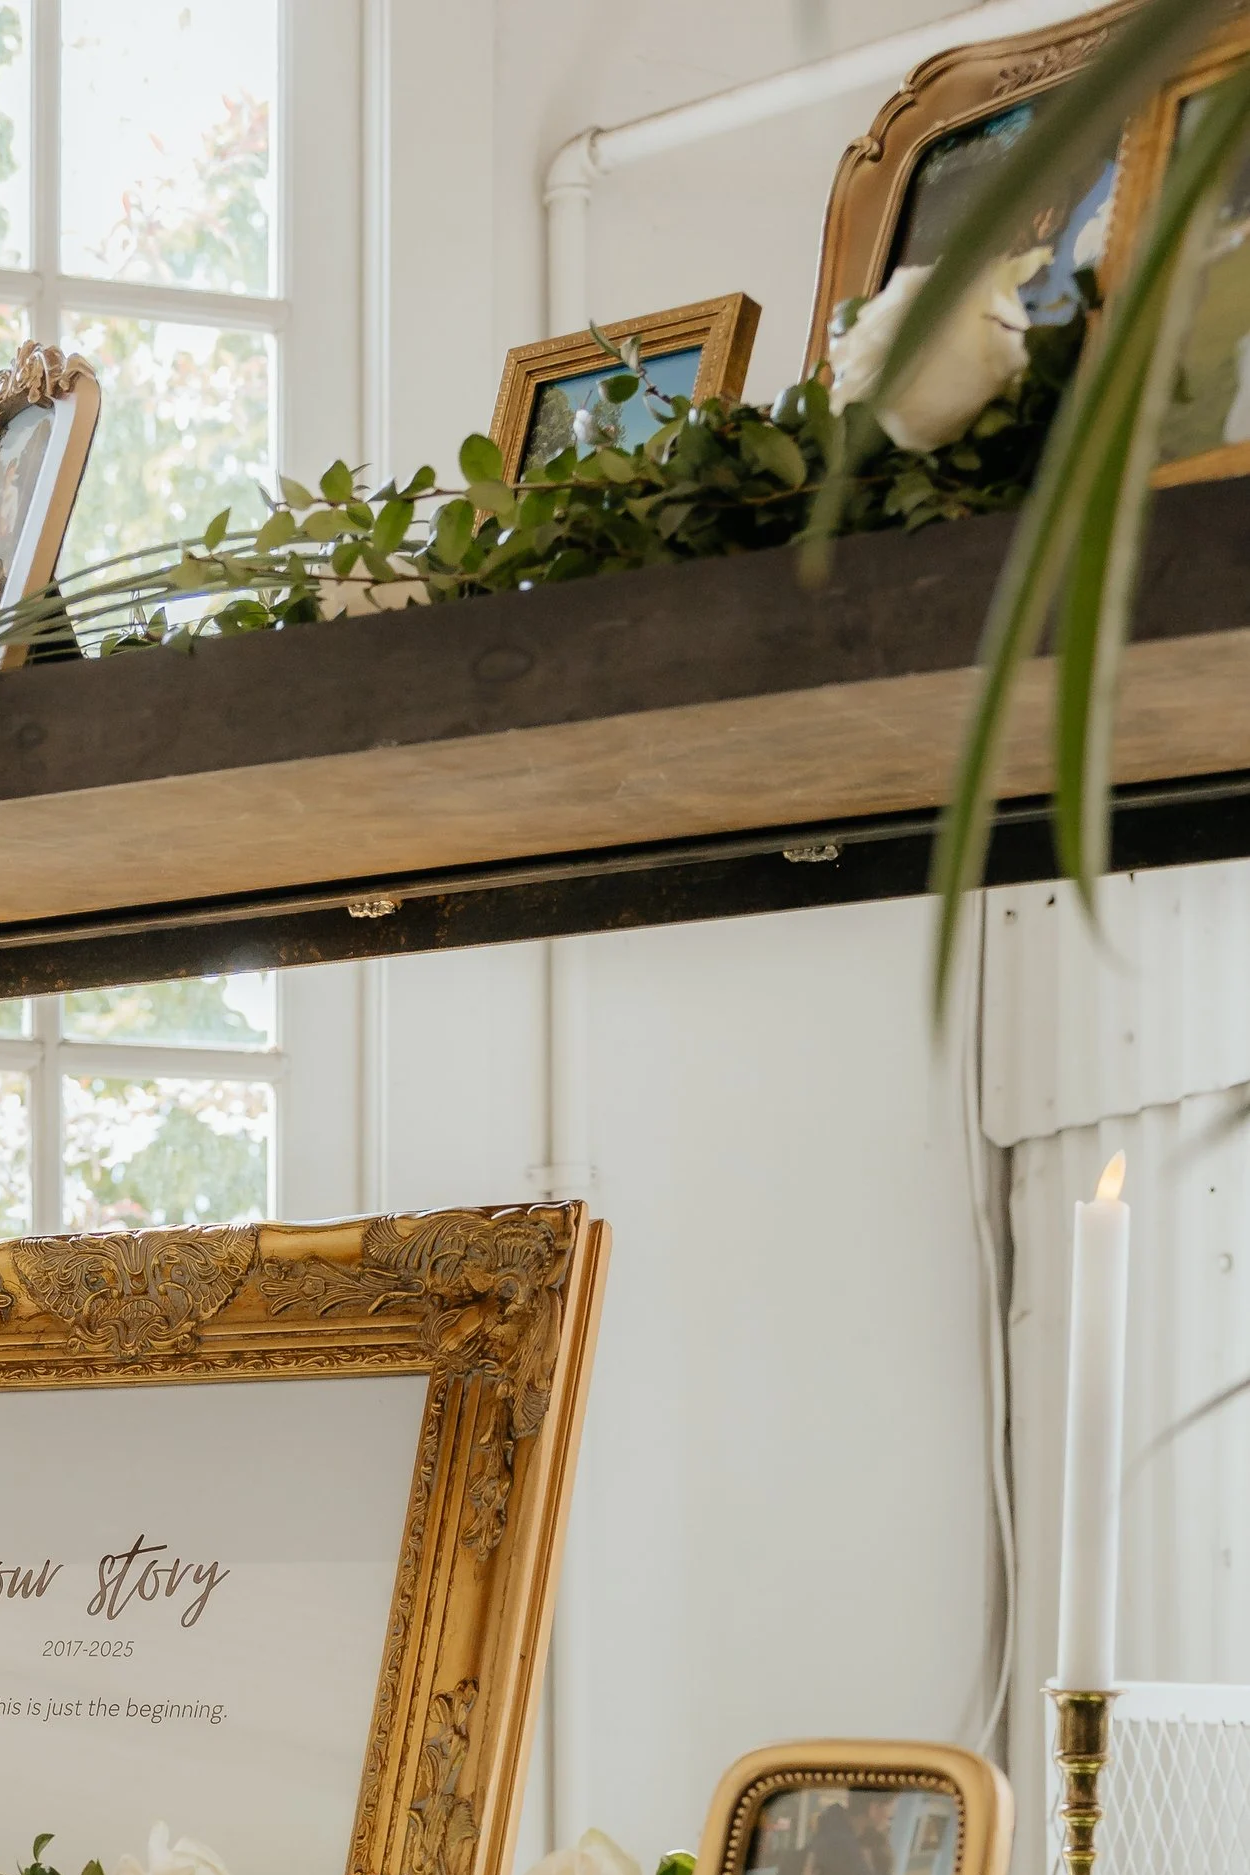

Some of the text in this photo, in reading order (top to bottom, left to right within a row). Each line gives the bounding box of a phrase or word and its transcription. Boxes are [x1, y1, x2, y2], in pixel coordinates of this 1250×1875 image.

[86, 1533, 231, 1628] story
[42, 1639, 136, 1658] 2017-2025
[26, 1697, 42, 1716] is
[42, 1697, 83, 1723] just
[87, 1696, 121, 1719] the
[125, 1696, 229, 1725] beginning.
